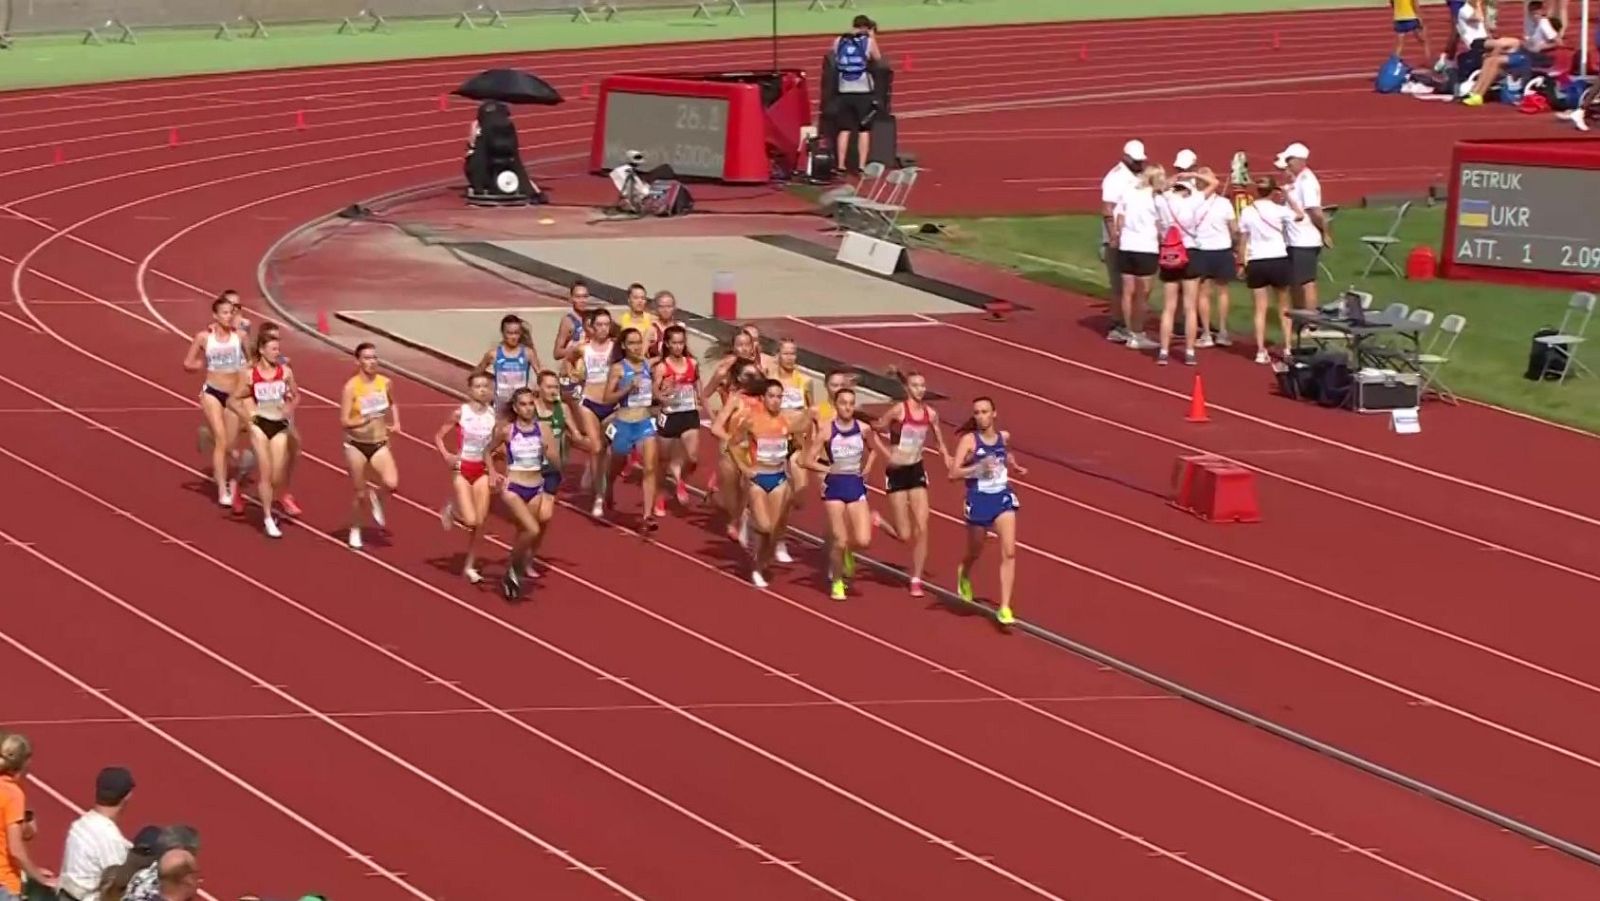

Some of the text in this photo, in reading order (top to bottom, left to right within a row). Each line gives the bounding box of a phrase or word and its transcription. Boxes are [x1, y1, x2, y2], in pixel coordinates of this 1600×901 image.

[1461, 169, 1522, 190] PETRUK
[1491, 205, 1530, 227] UKR
[1457, 238, 1600, 268] ATT. 1 2.09
